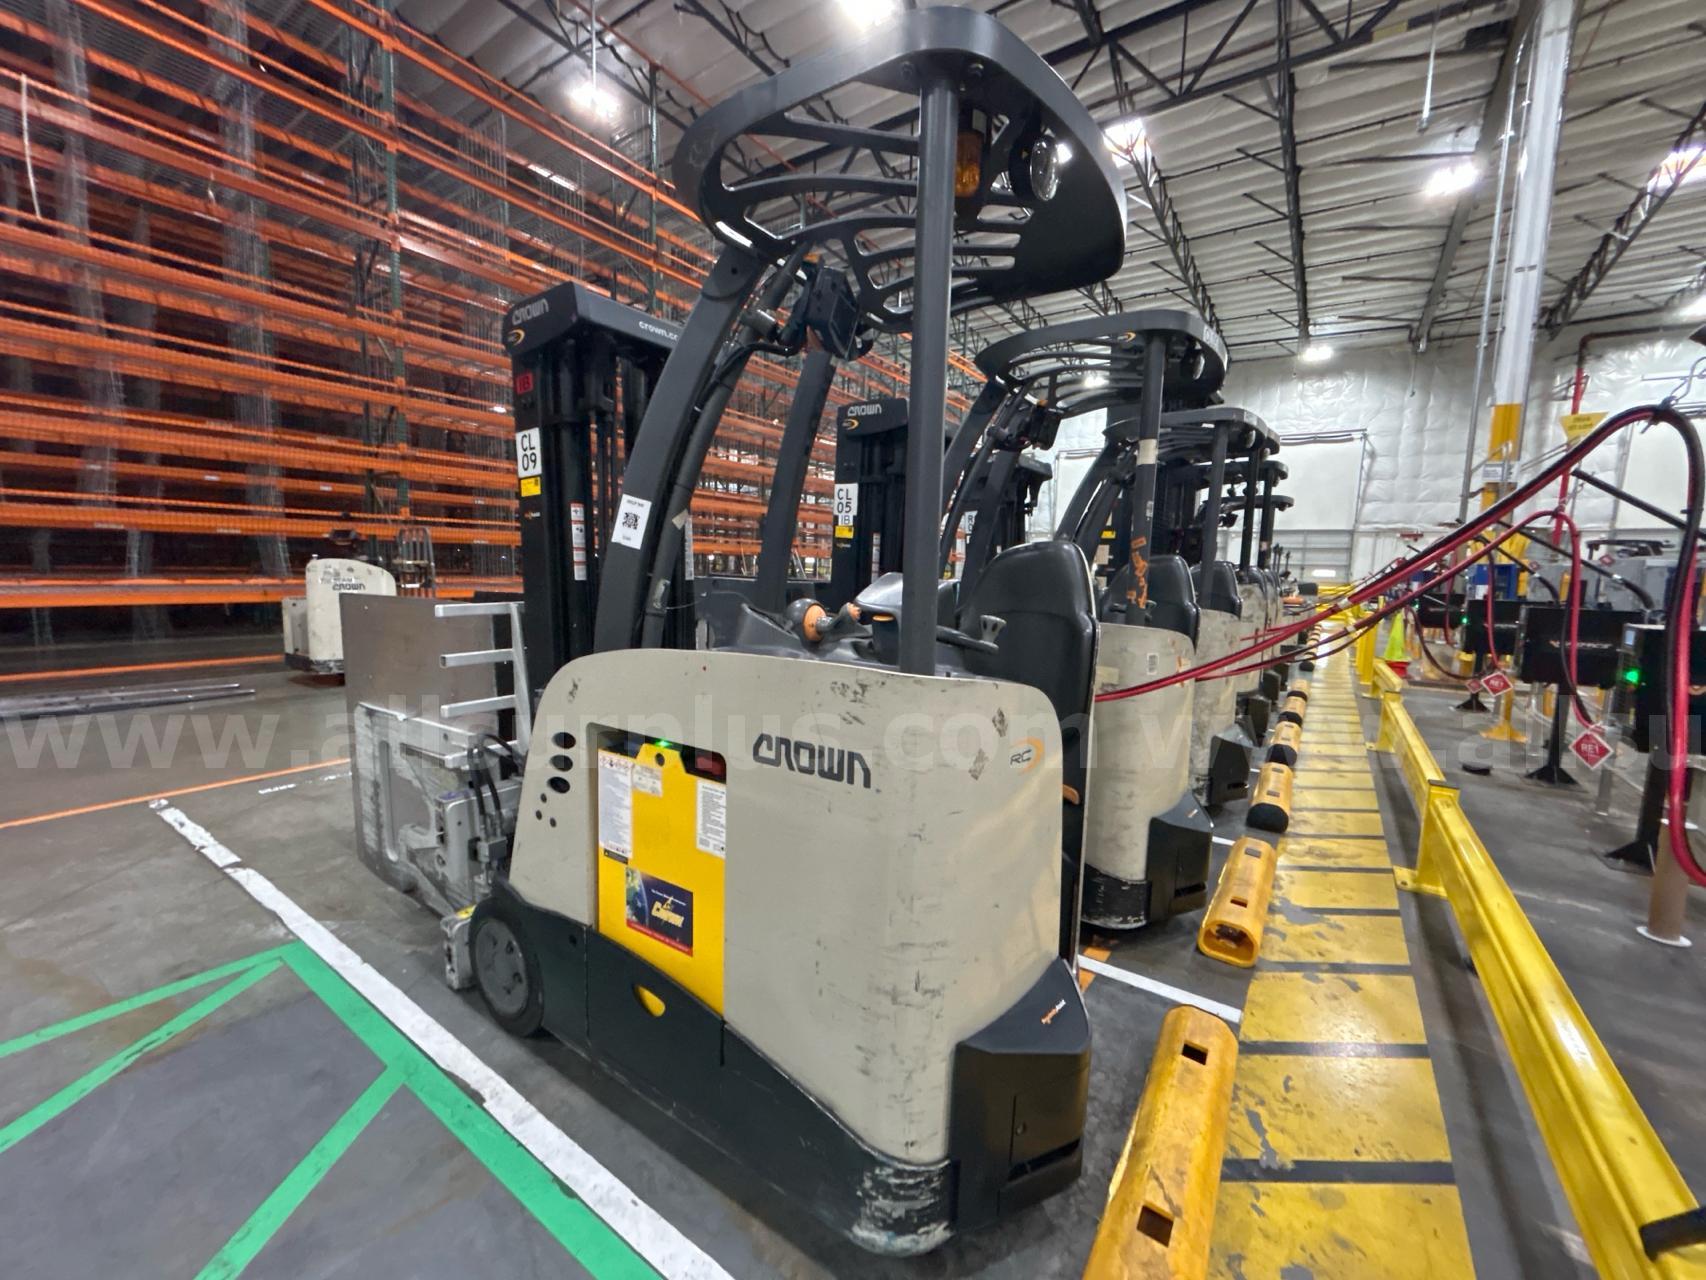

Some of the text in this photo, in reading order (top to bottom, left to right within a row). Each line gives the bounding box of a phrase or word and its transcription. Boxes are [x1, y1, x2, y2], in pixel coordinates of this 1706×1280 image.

[847, 403, 882, 417] CROWN
[520, 432, 536, 453] CL
[521, 453, 537, 472] 09
[836, 488, 852, 501] CL
[836, 501, 852, 513] 05
[752, 732, 871, 789] CROWN
[1010, 748, 1032, 765] RC
